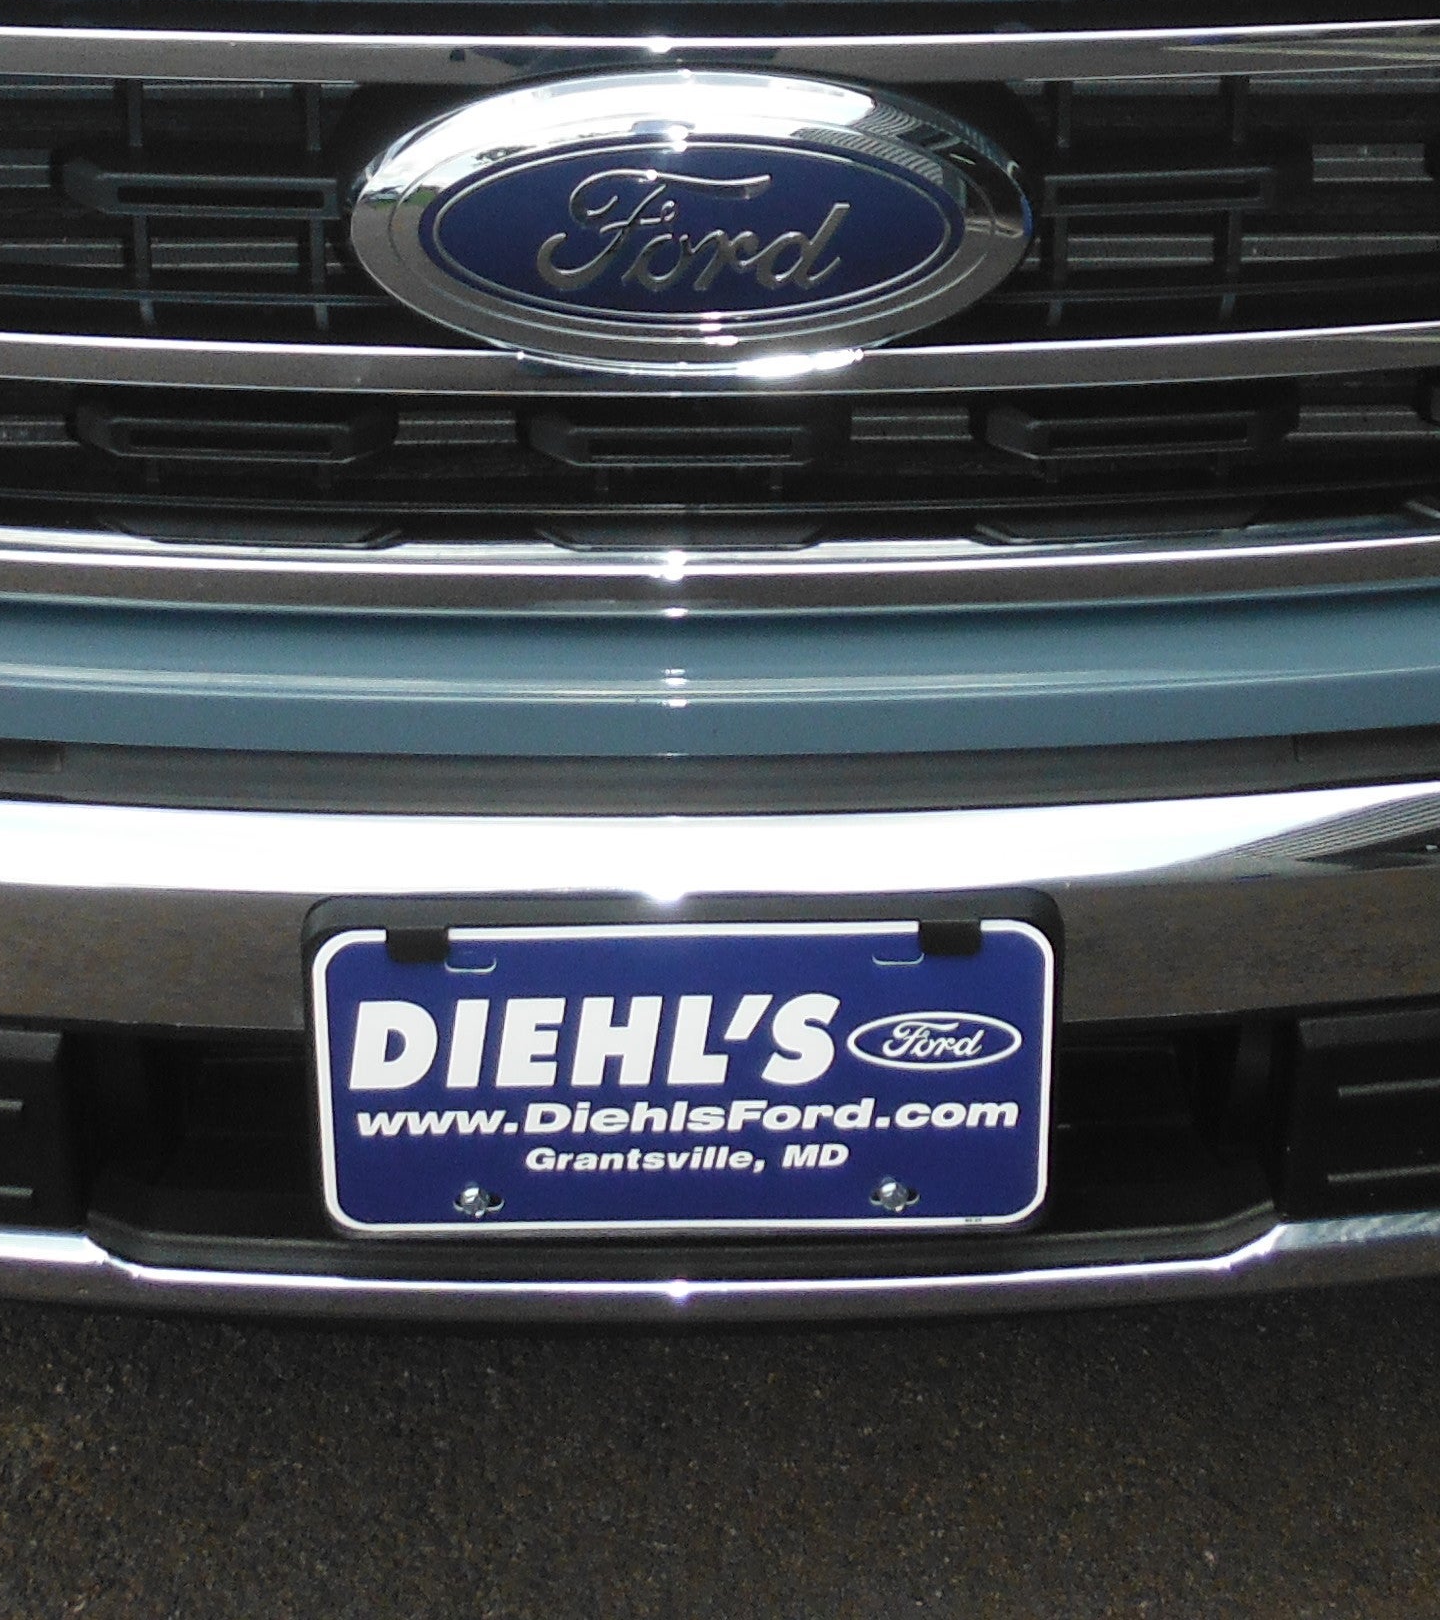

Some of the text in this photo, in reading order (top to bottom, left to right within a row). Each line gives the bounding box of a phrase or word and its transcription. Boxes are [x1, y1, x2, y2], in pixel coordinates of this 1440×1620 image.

[537, 168, 850, 291] Ford
[349, 993, 985, 1090] DIEHL'S Ford
[356, 1097, 1019, 1137] www.DiehlsFord.com
[525, 1142, 850, 1174] Grantsville, MD
